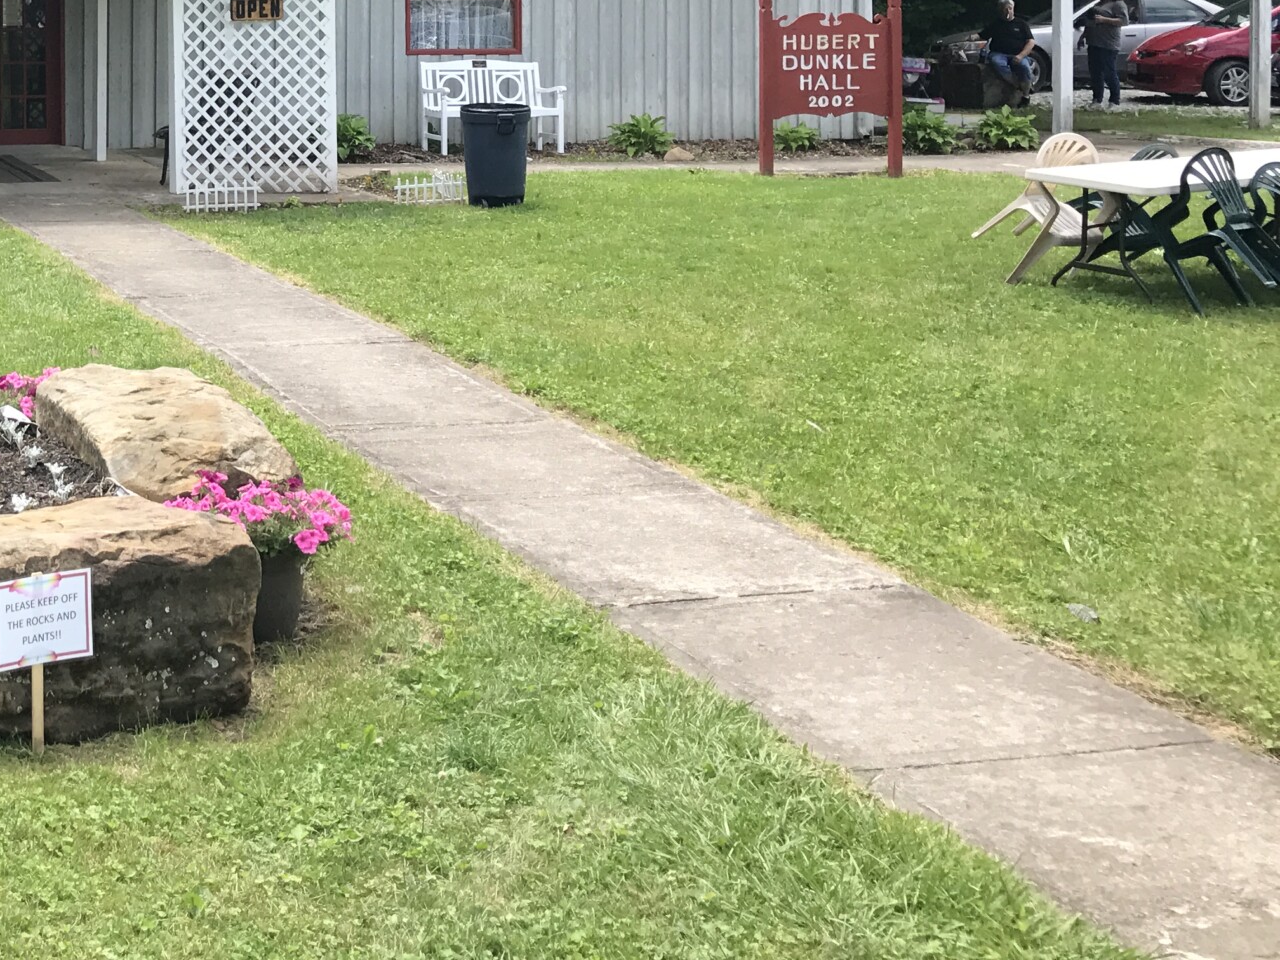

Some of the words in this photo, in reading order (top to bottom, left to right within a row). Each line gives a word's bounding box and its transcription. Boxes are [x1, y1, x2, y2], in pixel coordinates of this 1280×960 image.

[236, 0, 280, 19] OPEN
[783, 34, 880, 50] HUBERT
[782, 53, 876, 71] DUNKLE
[800, 74, 860, 91] HALL
[808, 95, 854, 108] 2002
[5, 599, 35, 613] PLEASE
[37, 595, 59, 607] KEEP
[61, 592, 78, 604] OFF
[8, 619, 24, 630] THE
[26, 614, 55, 627] ROCKS
[56, 610, 77, 622] AND
[22, 630, 62, 645] PLANTS!!
